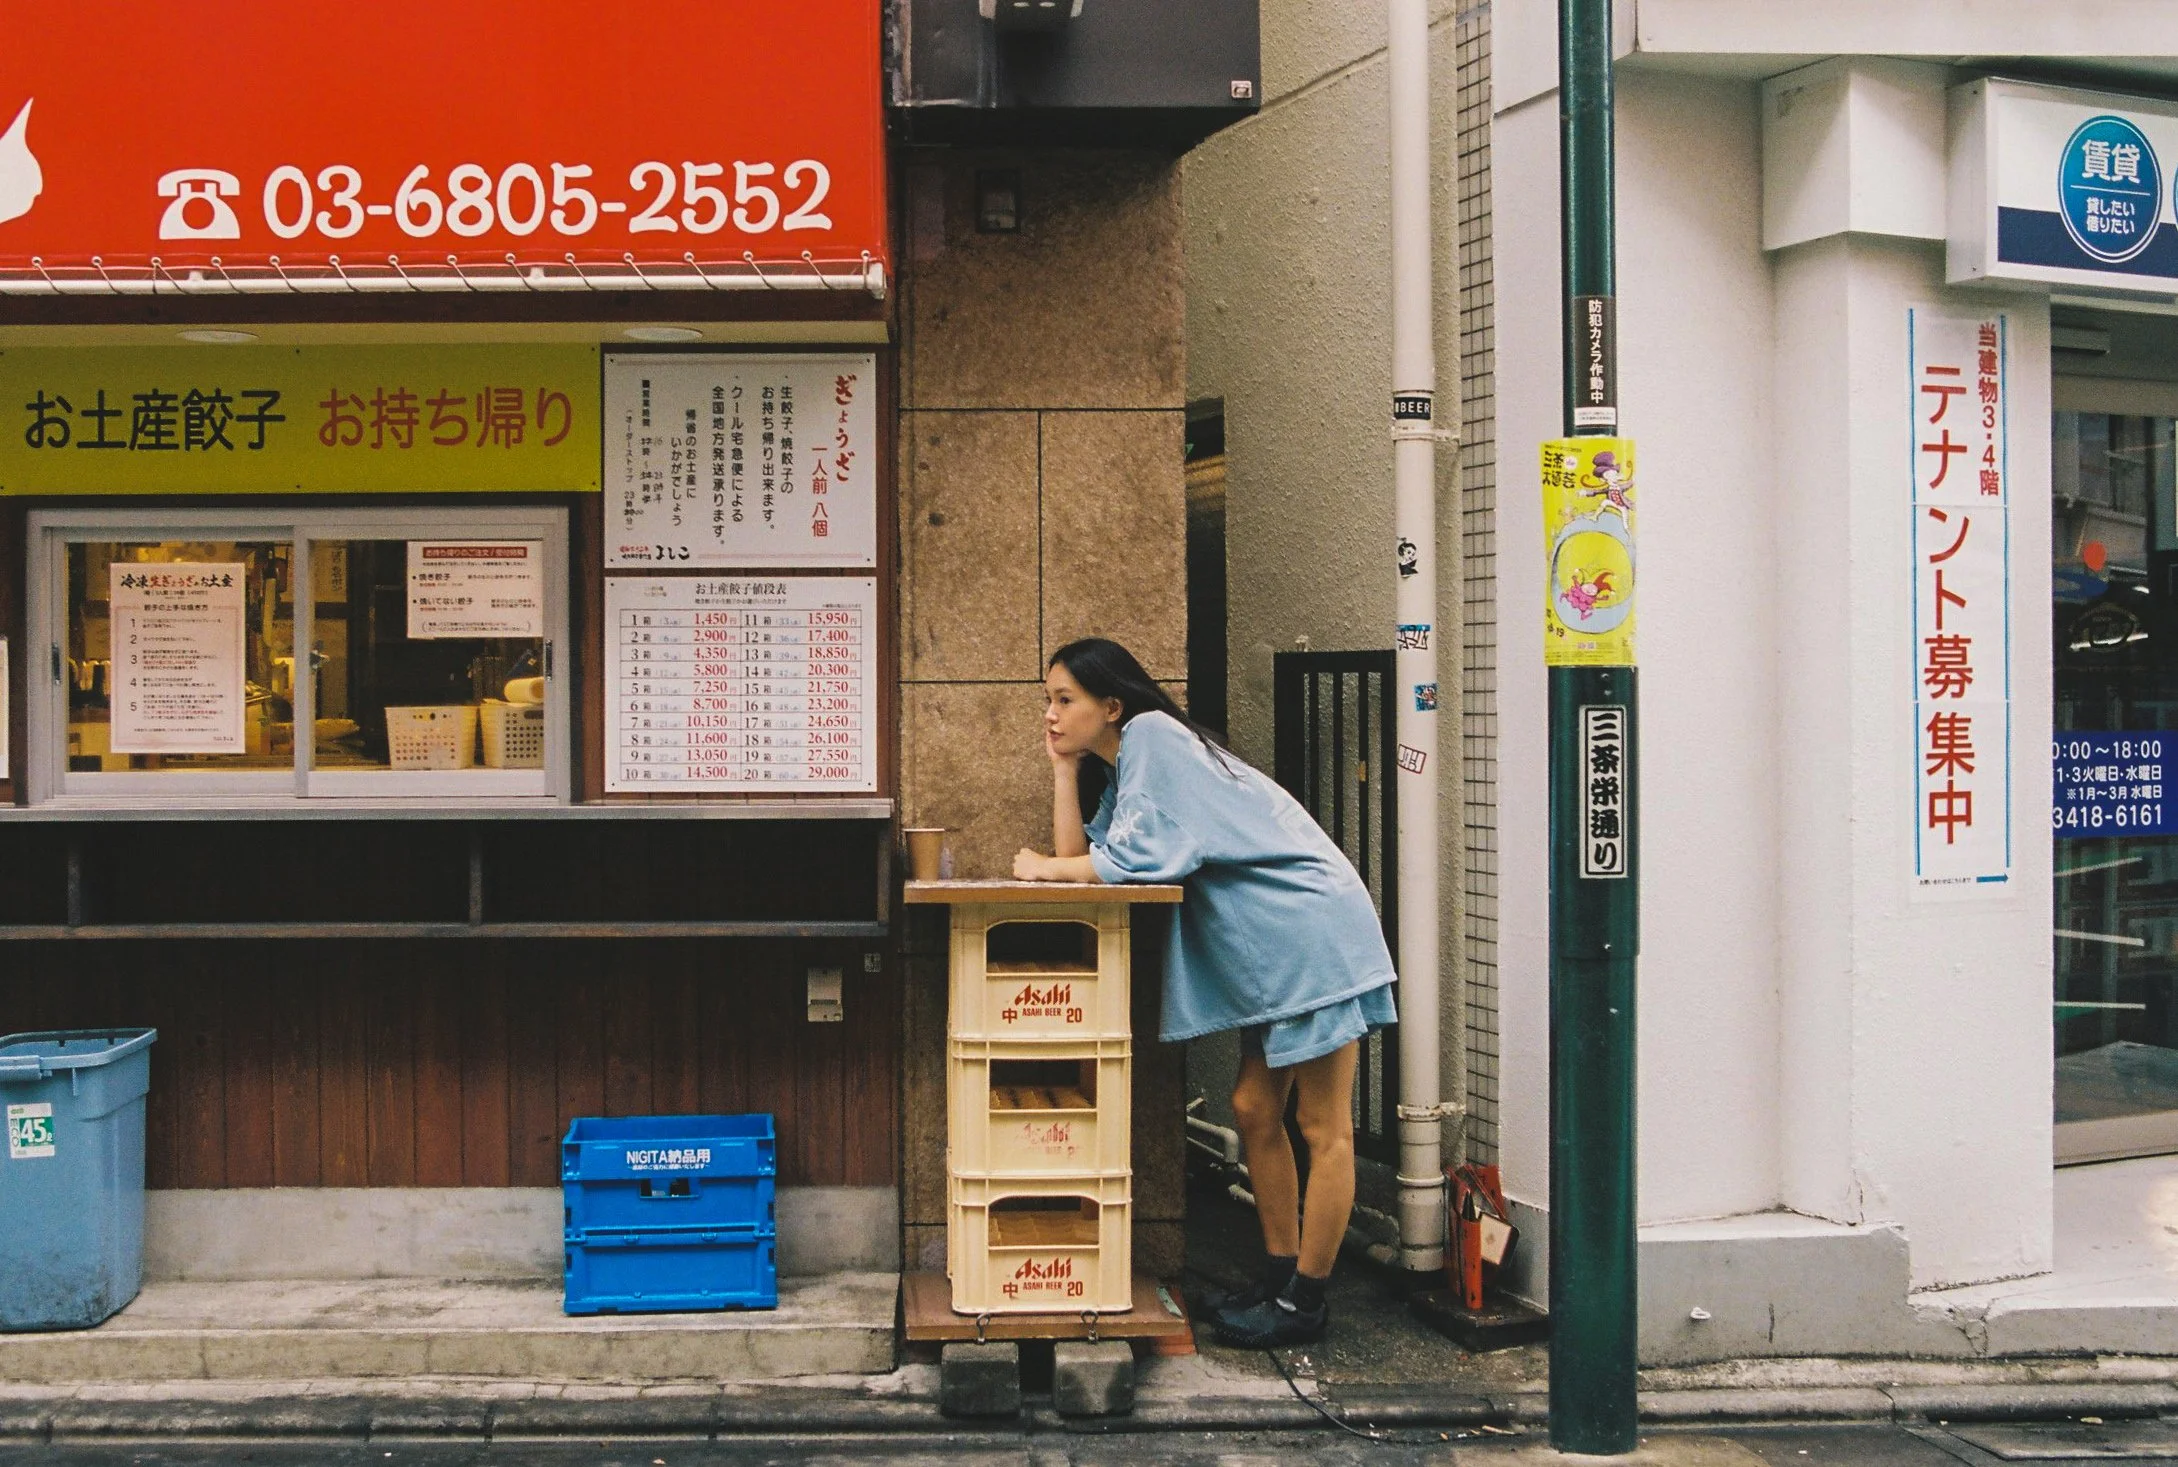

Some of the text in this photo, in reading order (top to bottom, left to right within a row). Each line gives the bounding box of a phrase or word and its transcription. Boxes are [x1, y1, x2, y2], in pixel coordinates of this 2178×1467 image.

[2082, 139, 2140, 183] 賃貸
[263, 160, 832, 239] 03-6805-2552
[2087, 197, 2135, 216] 貸したい
[2087, 217, 2135, 235] 借りたい
[1588, 299, 1604, 404] 防犯カメラ作動中
[24, 387, 575, 452] お土産餃子 お持ち帰り
[835, 374, 857, 482] ぎょうざ
[762, 386, 776, 529] お持ち帰り出来ます。
[671, 437, 682, 526] いかがでしょう
[812, 447, 828, 537] 一人前 八個
[695, 583, 787, 596] お土産餃子値段表
[1921, 366, 1976, 846] テナント募集中
[131, 619, 135, 628] 1
[130, 635, 137, 644] 2
[131, 655, 137, 664] 3
[130, 678, 137, 687] 4
[130, 702, 137, 711] 5
[2053, 765, 2162, 782] 1・3火曜日・水曜日
[1590, 713, 1620, 870] 三茶栄通り
[2053, 804, 2161, 828] 3418-6161
[1015, 983, 1071, 1006] Asahi
[1002, 1008, 1083, 1025] 中 ASAHI BEER 20
[1016, 1257, 1072, 1280] Asahi
[1003, 1282, 1084, 1299] 中 ASAHI BEER 20
